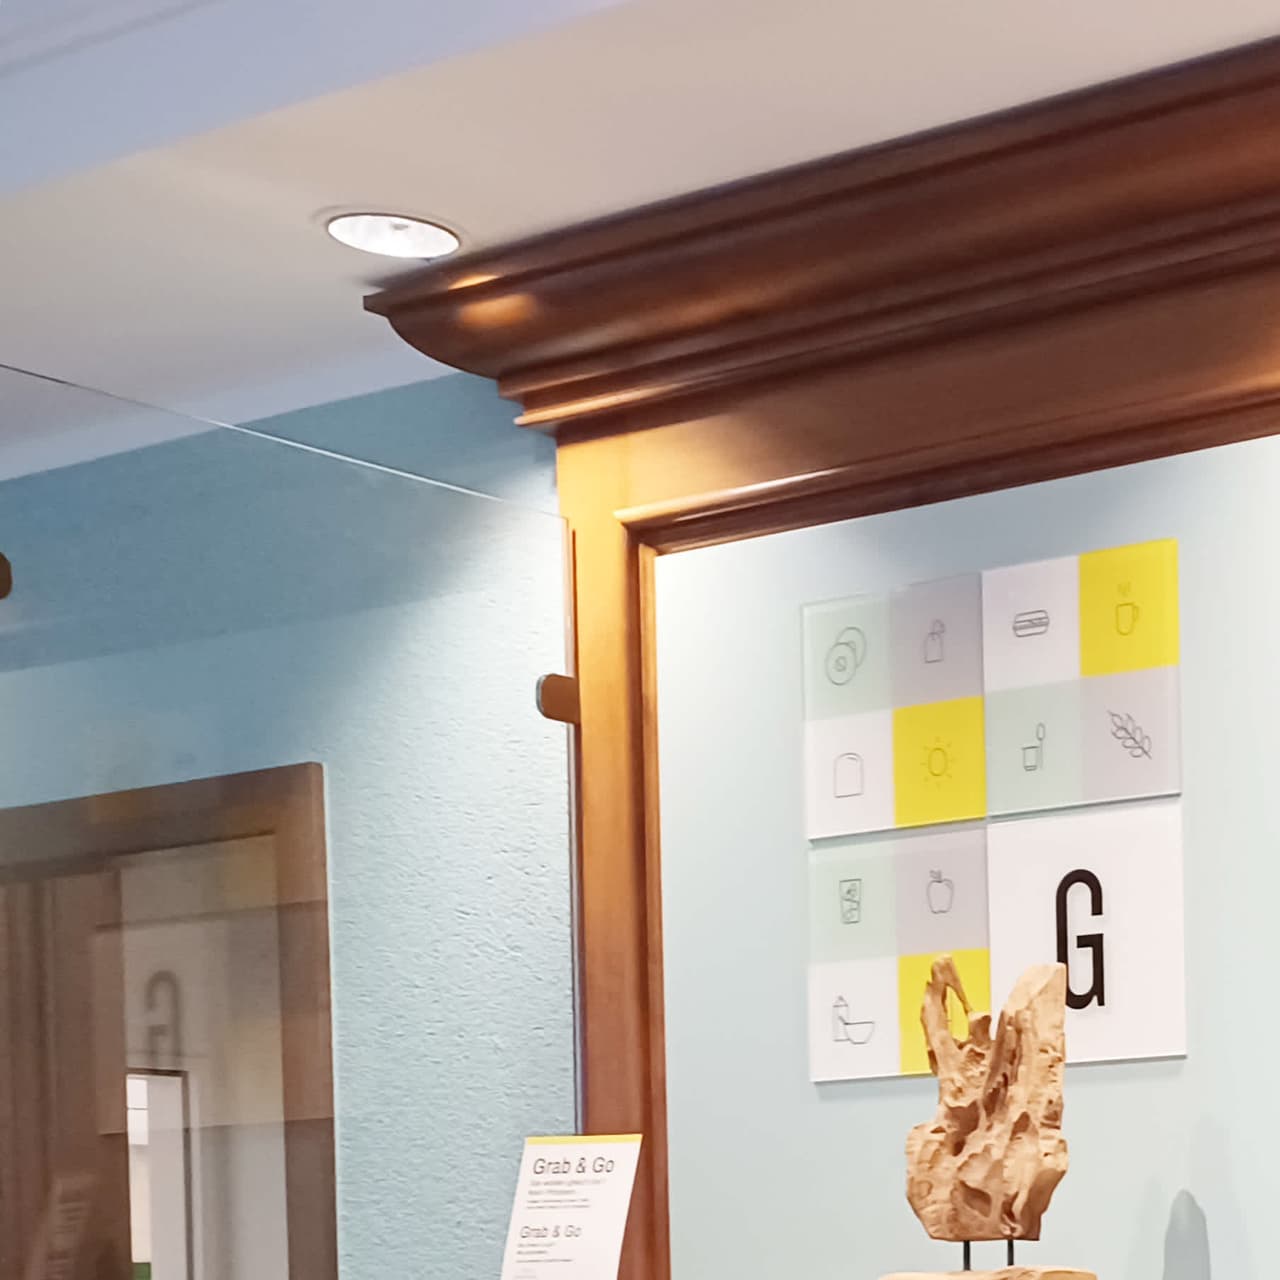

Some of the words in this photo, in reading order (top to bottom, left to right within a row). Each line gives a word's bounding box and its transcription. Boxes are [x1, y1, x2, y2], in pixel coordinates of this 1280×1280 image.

[1055, 868, 1105, 1010] G
[532, 1157, 572, 1175] Grab
[575, 1156, 586, 1174] &
[592, 1156, 615, 1174] Go
